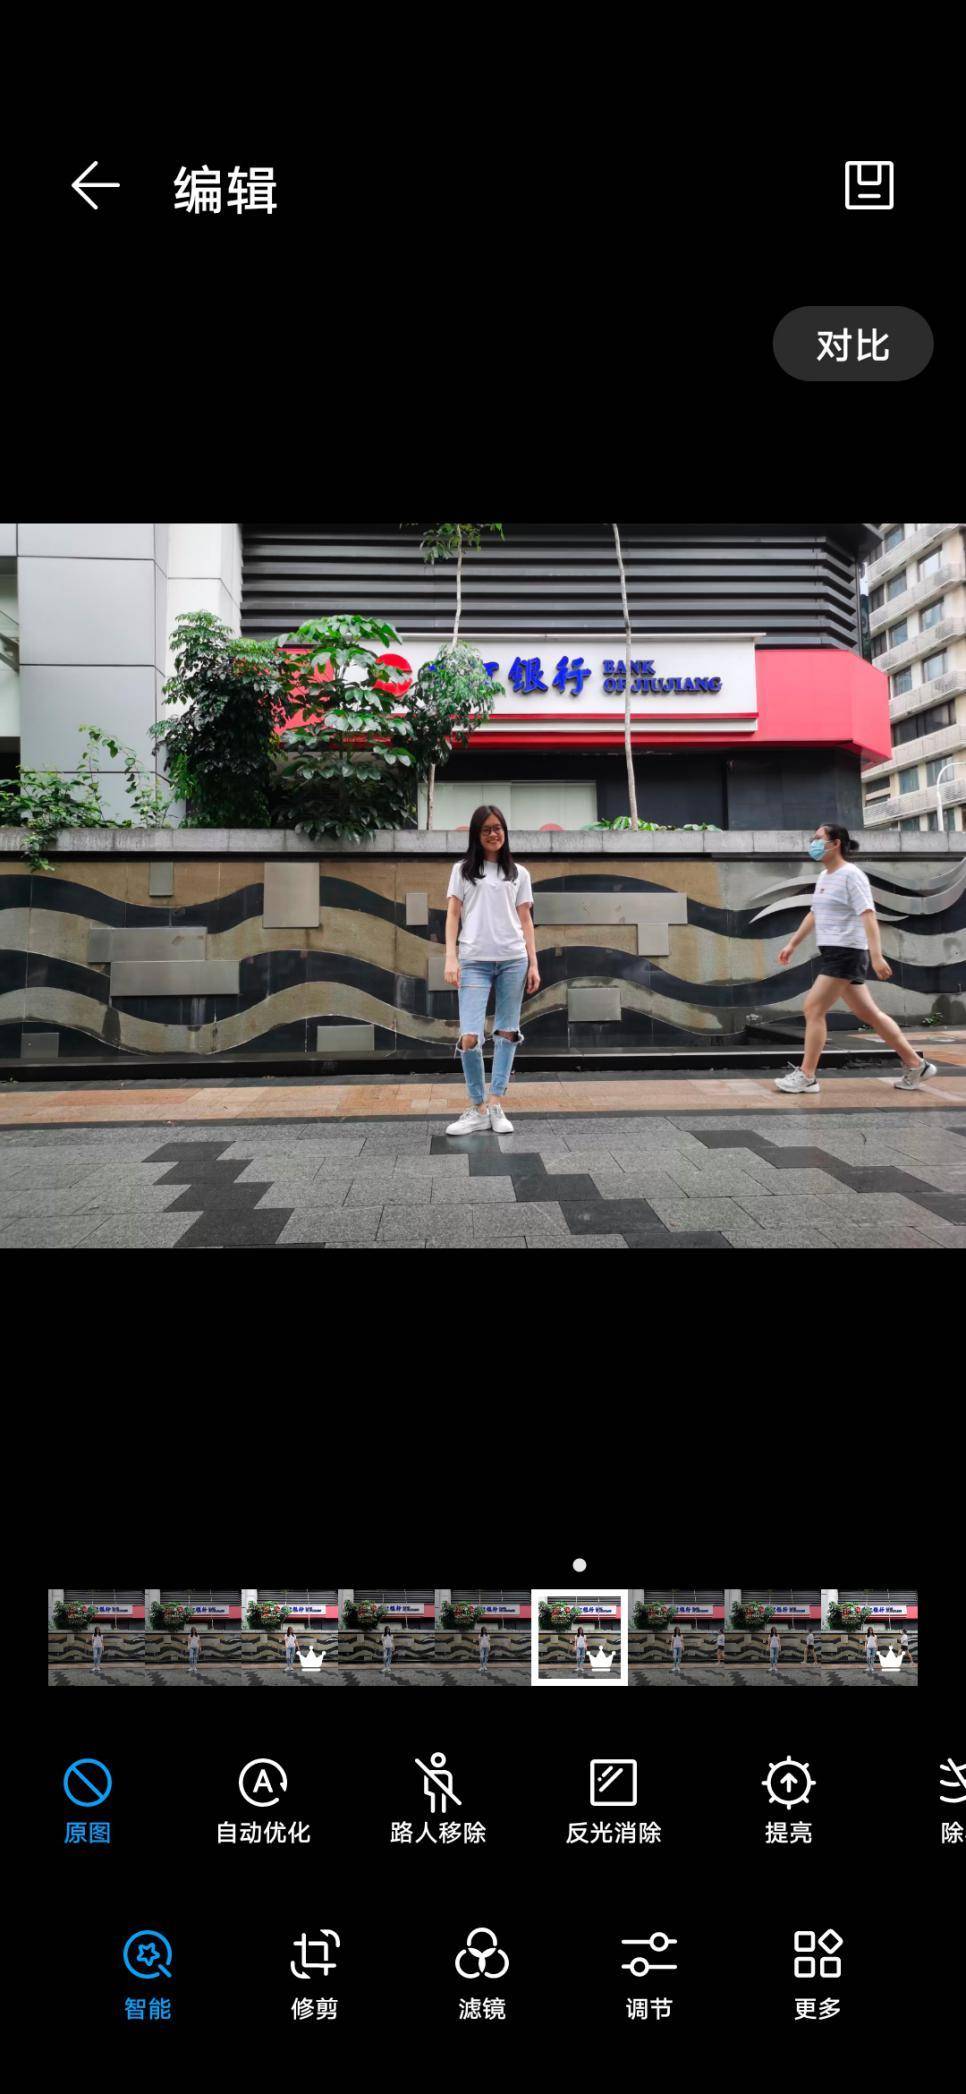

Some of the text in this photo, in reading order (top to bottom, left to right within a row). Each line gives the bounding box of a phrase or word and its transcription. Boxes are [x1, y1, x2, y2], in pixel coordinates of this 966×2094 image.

[174, 165, 277, 214] 编辑
[817, 328, 889, 362] 对比
[603, 660, 656, 676] BANK
[630, 677, 722, 694] JIUJIANG
[64, 1822, 110, 1843] 原图
[217, 1821, 310, 1843] 自动优化
[390, 1821, 486, 1844] 路人移除
[566, 1821, 661, 1843] 反光消除
[765, 1821, 812, 1843] 提亮
[942, 1821, 966, 1844] 除
[124, 1997, 171, 2020] 智能
[291, 1997, 338, 2020] 修剪
[459, 1997, 505, 2020] 滤镜
[626, 1997, 673, 2020] 调节
[795, 1997, 841, 2020] 更多
